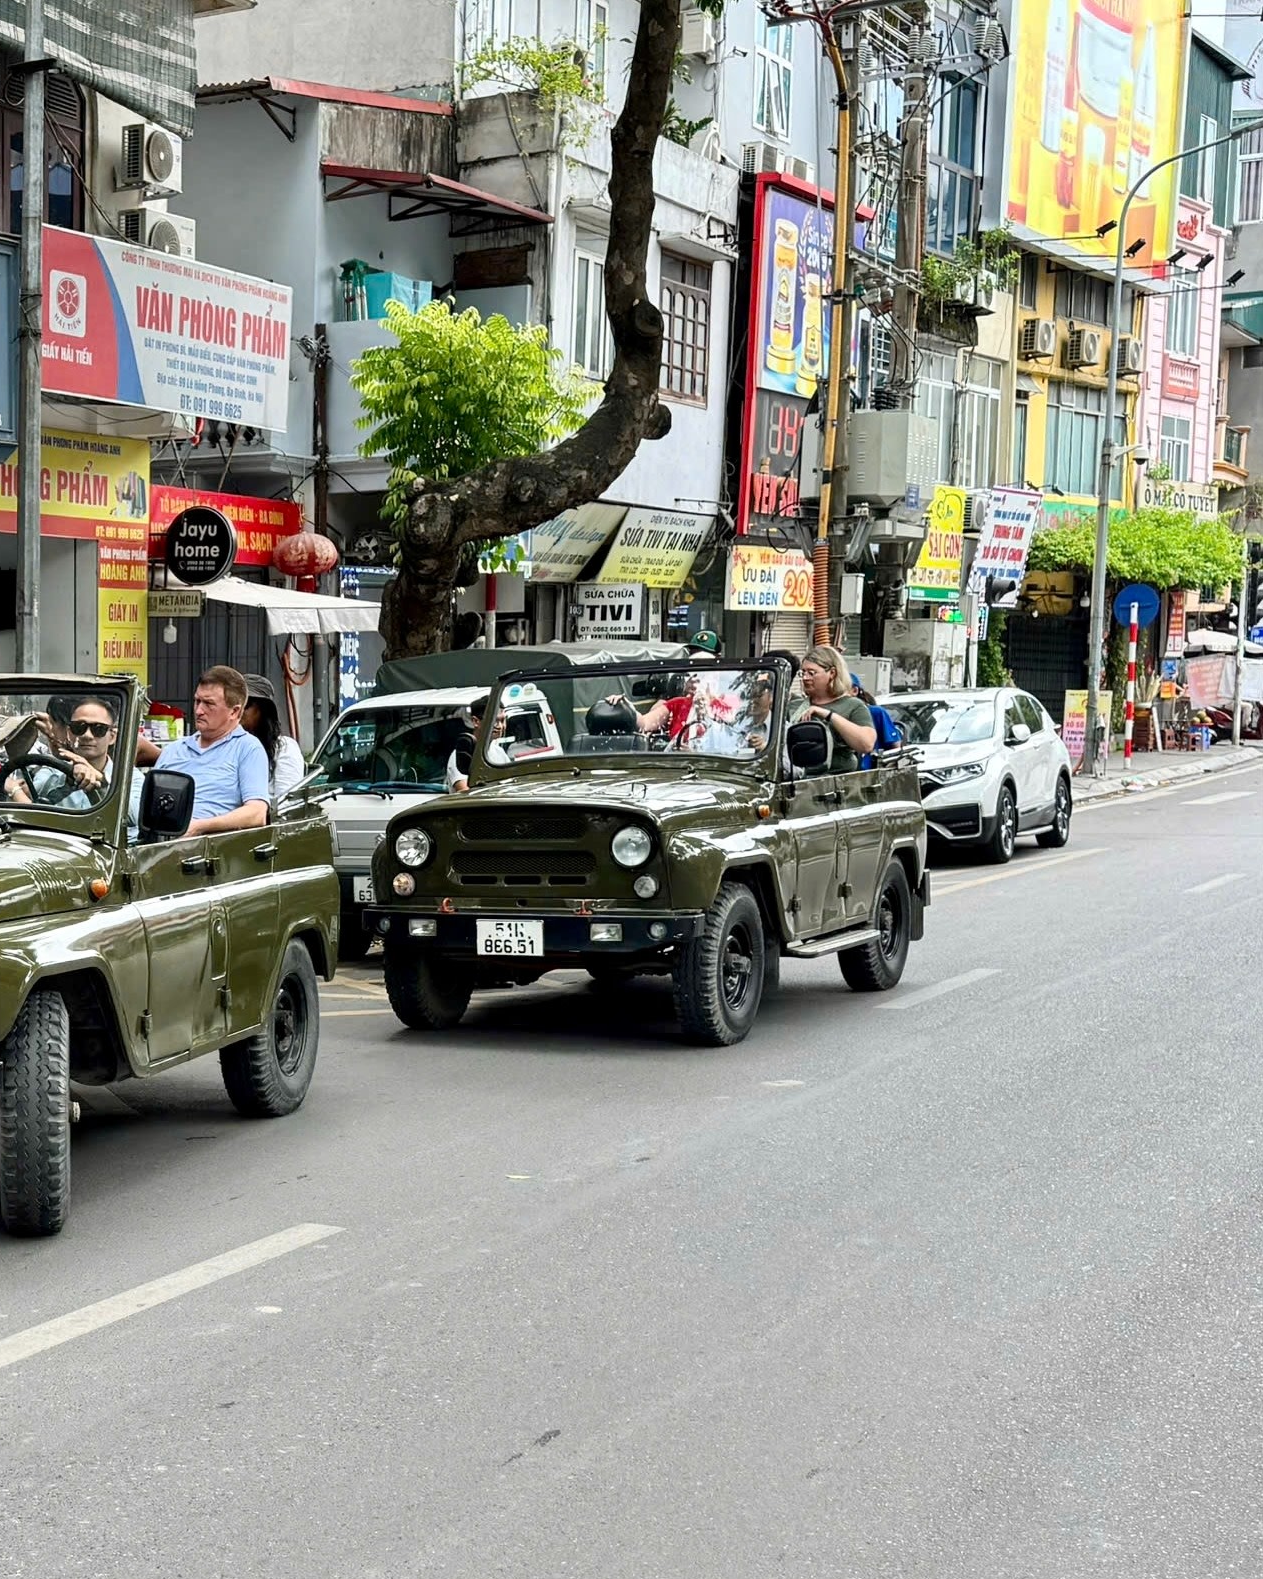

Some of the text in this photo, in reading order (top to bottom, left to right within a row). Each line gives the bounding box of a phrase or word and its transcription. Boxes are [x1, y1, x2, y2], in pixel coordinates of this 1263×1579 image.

[136, 281, 286, 361] VĂN PHÒNG PHẨM
[41, 340, 59, 360] GIẤY
[193, 396, 207, 413] 091
[208, 399, 223, 416] 999
[224, 402, 242, 419] 6625
[56, 460, 109, 507] PHẨM
[179, 517, 218, 541] jayu
[619, 520, 642, 547] SỬA
[642, 528, 664, 549] TIVI
[664, 531, 678, 554] TẠI
[174, 541, 220, 558] home
[100, 560, 147, 581] HOÀNG ANH
[584, 587, 635, 599] SỬA CHỮA
[129, 603, 138, 623] IN
[586, 604, 633, 621] TIVI
